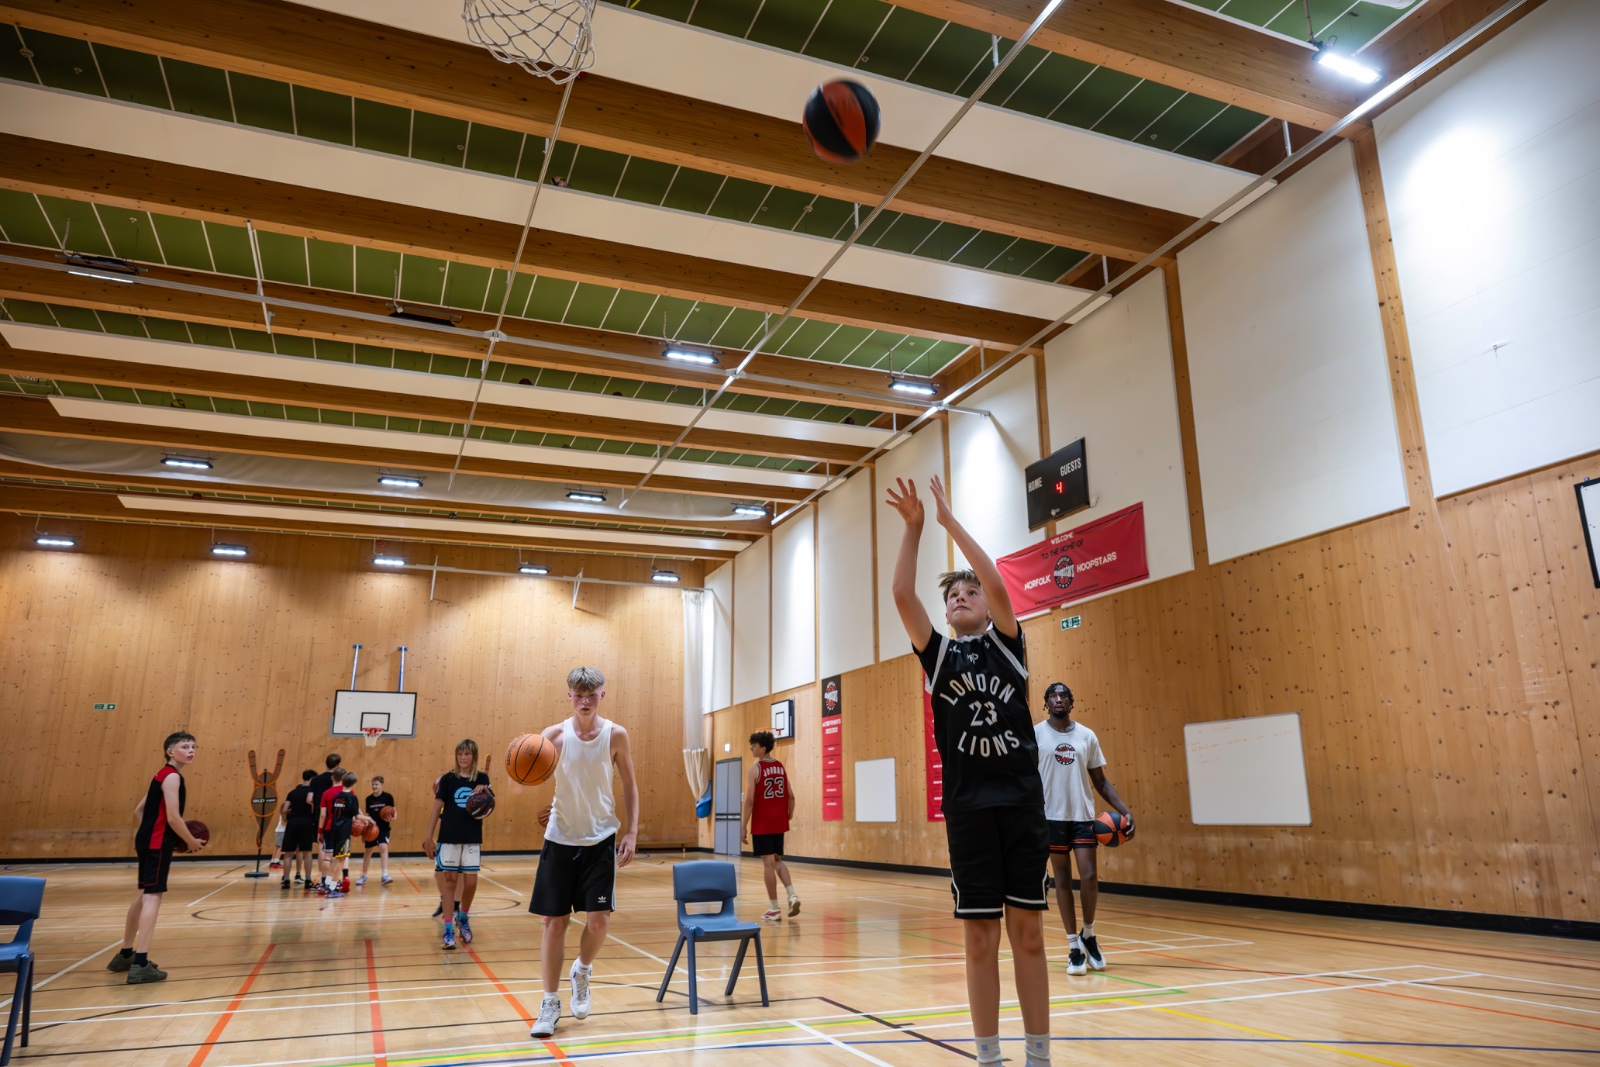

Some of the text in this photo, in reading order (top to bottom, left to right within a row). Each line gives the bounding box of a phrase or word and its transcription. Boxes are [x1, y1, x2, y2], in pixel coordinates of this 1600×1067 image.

[1060, 458, 1082, 477] GUESTS
[1028, 477, 1043, 493] HOME
[1055, 481, 1063, 494] 4
[1041, 538, 1084, 560] TO THE HOME OF
[1050, 532, 1074, 545] WELCOME
[1076, 551, 1117, 573] HOOPSTARS
[1024, 574, 1051, 591] NORFOLK
[939, 671, 1016, 706] LONDON
[968, 700, 998, 727] 23
[957, 730, 1020, 758] LIONS
[763, 776, 785, 799] 23
